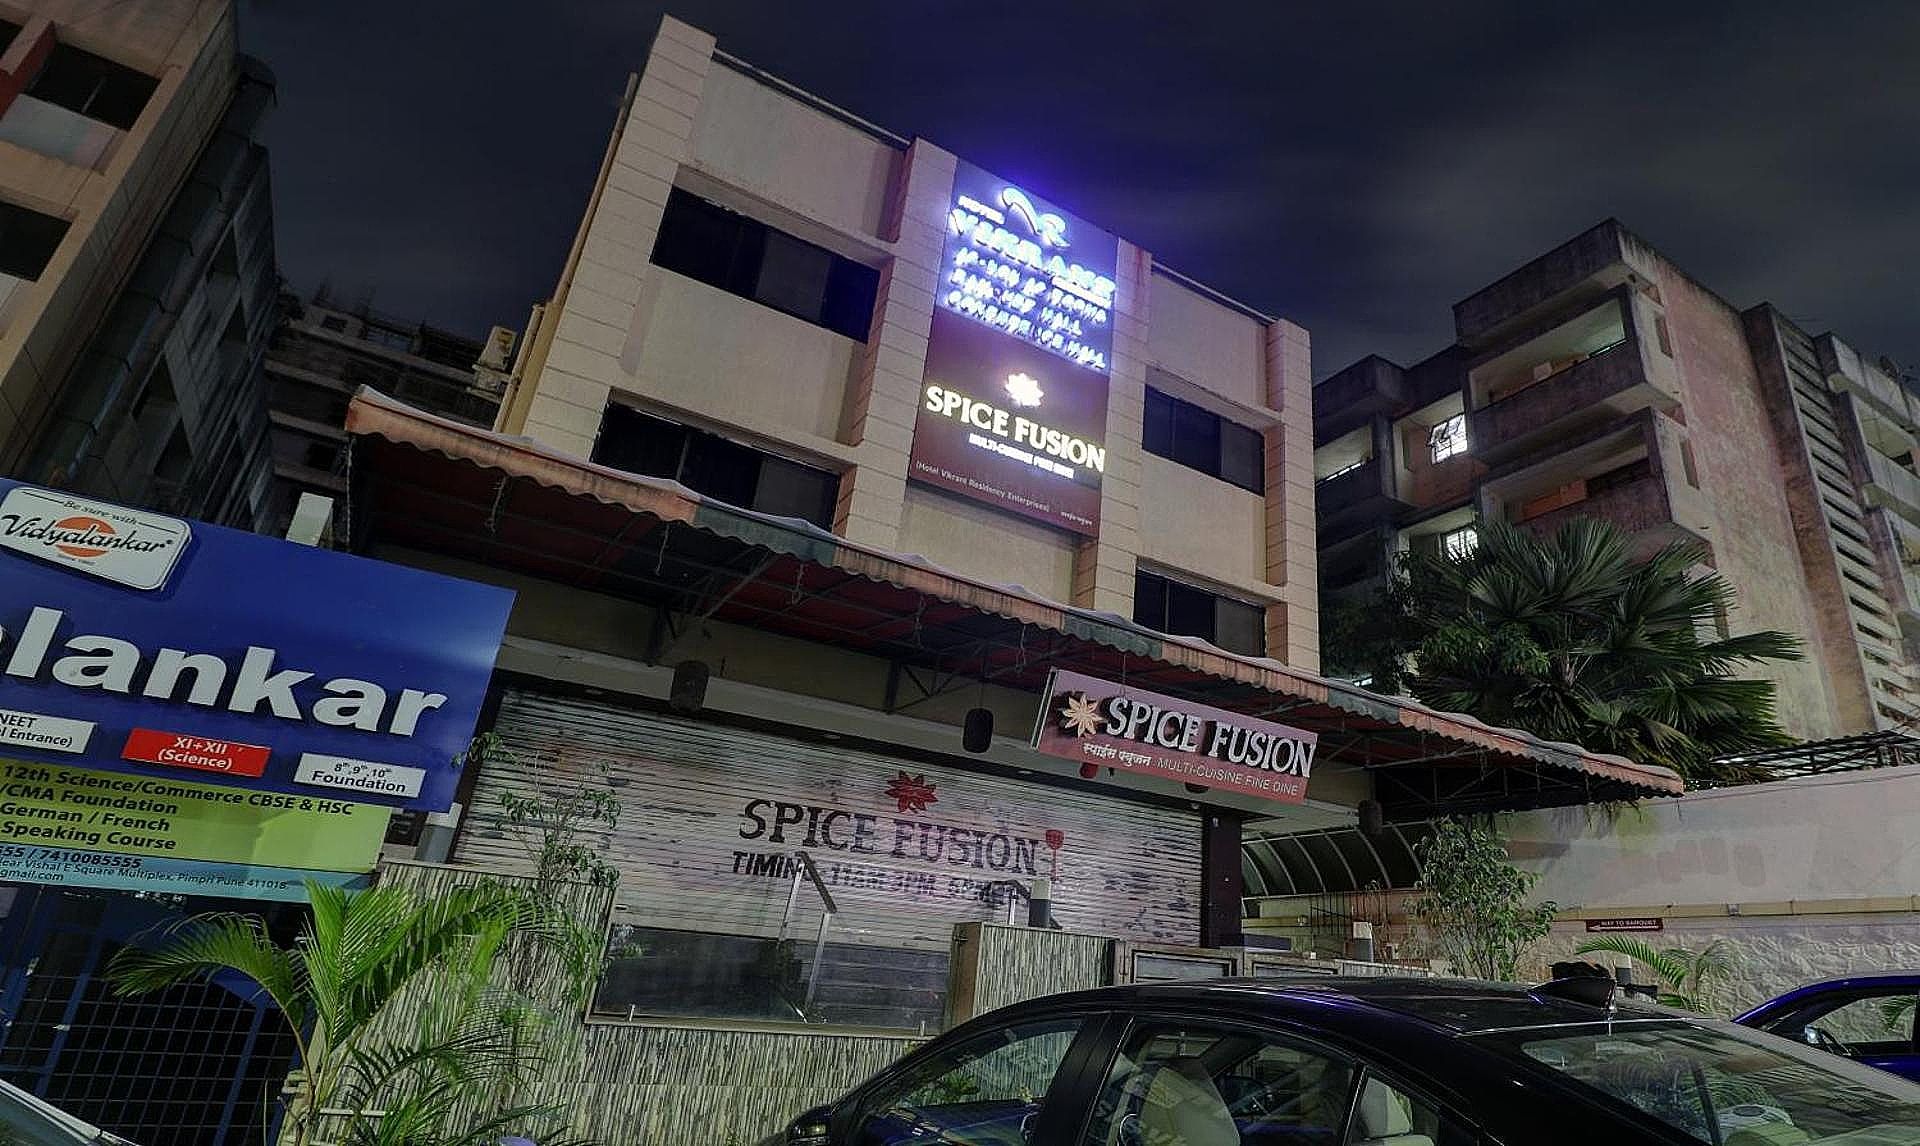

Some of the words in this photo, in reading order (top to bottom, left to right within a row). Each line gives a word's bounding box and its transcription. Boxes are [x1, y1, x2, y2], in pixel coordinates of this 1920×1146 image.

[1039, 306, 1083, 337] HALL
[1067, 340, 1106, 369] HALL
[926, 385, 1010, 438] SPICE
[1015, 416, 1106, 473] FUSION
[64, 501, 81, 511] Be
[81, 506, 110, 517] sure
[112, 513, 138, 525] with
[0, 606, 447, 737] lankar
[10, 729, 72, 748] Entrance)
[1106, 697, 1200, 753] SPICE
[1207, 721, 1317, 779] FUSION
[158, 748, 232, 770] (Science)
[5, 765, 49, 783] 12th
[56, 772, 243, 804] Science/Commerce
[248, 789, 295, 809] CBSE
[300, 799, 313, 811] &
[318, 802, 355, 815] HSC
[312, 770, 406, 793] Foundation
[1157, 758, 1244, 785] MULTI-CUISINE
[1246, 776, 1271, 790] FINE
[1273, 782, 1298, 796] DINE
[60, 790, 178, 814] Foundation
[1, 802, 82, 823] German
[88, 811, 99, 823] /
[102, 812, 170, 832] French
[1, 821, 100, 846] Speaking
[107, 831, 176, 850] Course
[739, 799, 877, 853] SPICE
[890, 818, 1039, 875] FUSION
[0, 858, 22, 868] ear
[25, 860, 61, 871] Vishal
[73, 863, 114, 876] Square
[216, 876, 245, 887] Pune
[28, 849, 37, 858] /
[40, 849, 142, 868] 7410085555
